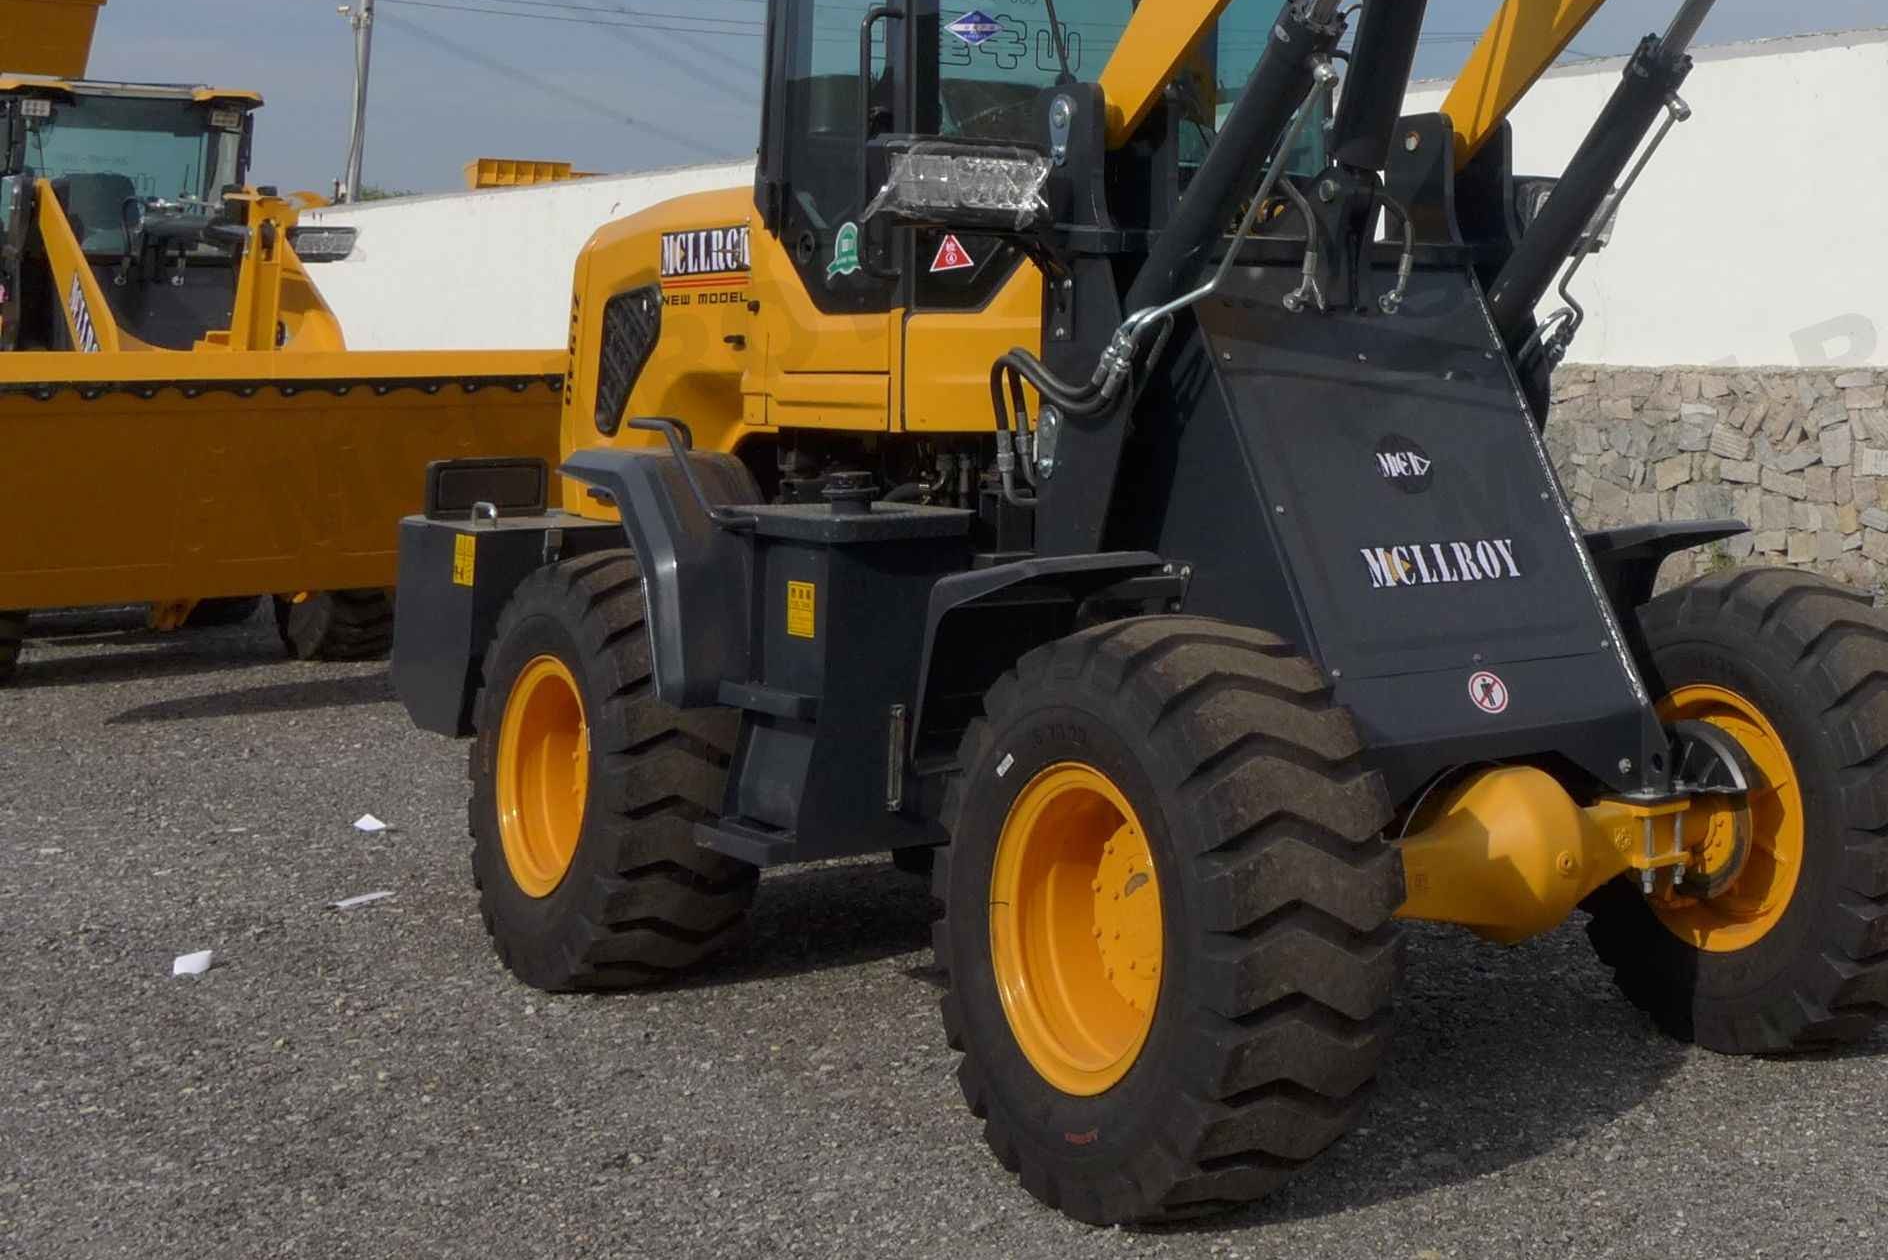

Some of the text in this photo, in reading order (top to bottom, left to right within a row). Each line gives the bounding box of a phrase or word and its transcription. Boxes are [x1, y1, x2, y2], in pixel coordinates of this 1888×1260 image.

[662, 291, 748, 306] NEW MODEL
[1360, 538, 1521, 588] MCLLROY
